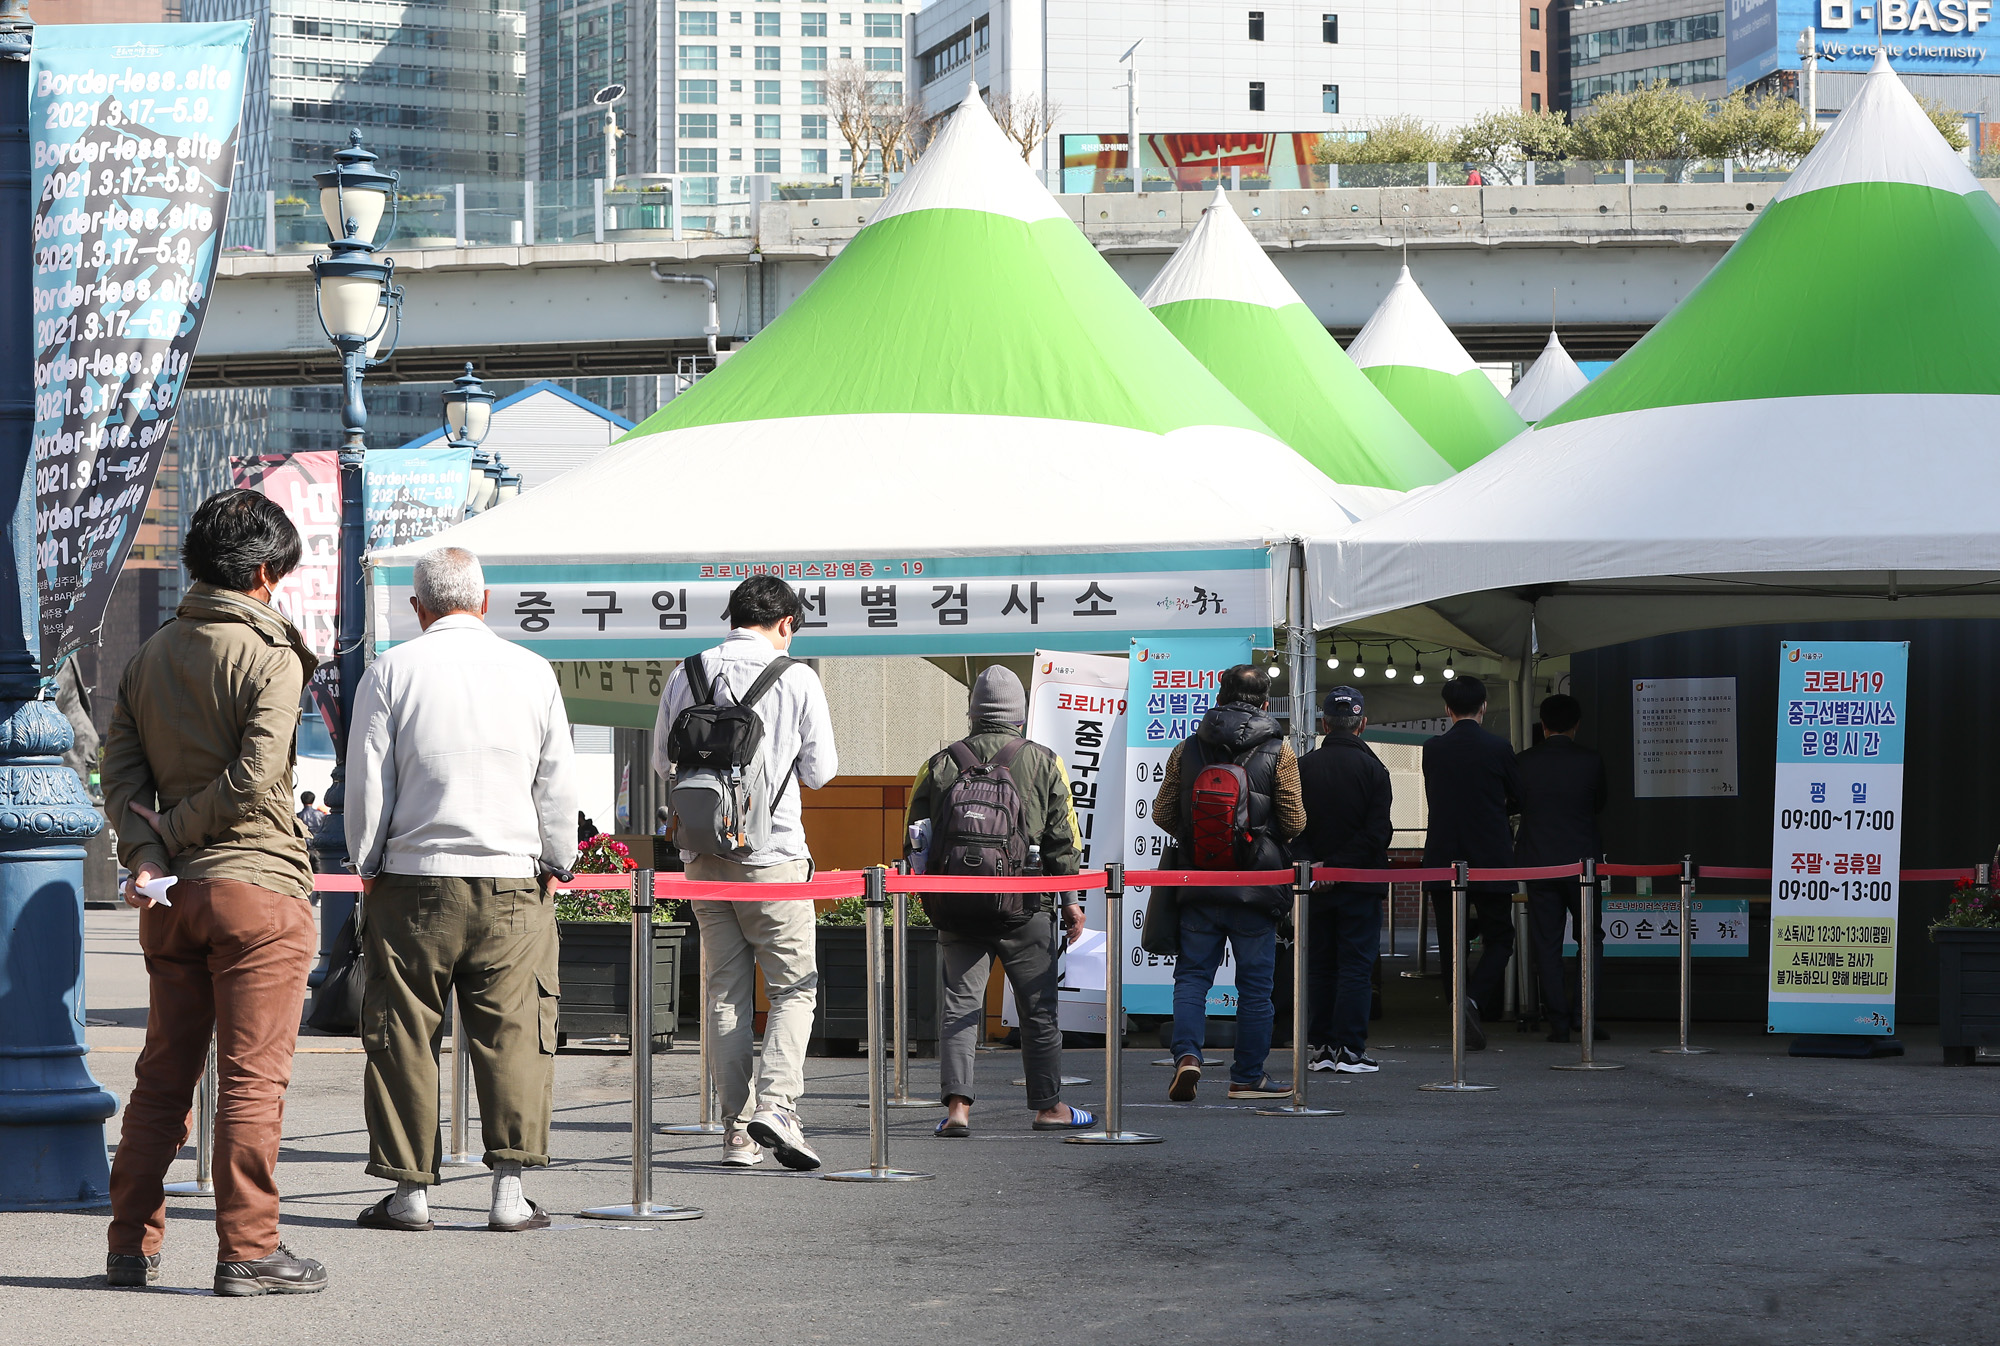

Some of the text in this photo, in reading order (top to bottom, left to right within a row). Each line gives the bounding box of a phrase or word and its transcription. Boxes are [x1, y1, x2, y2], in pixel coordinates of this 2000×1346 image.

[1882, 0, 1992, 33] BASF
[1822, 41, 1847, 55] We
[1908, 43, 1988, 61] chemistry
[699, 562, 875, 579] 코로나바이러스감염증
[900, 562, 925, 576] 19
[514, 581, 1118, 633] 중구임선별검사소
[1192, 585, 1225, 616] 중구
[1803, 671, 1884, 693] 코로나19
[1057, 692, 1127, 716] 코로나19
[1147, 693, 1216, 715] 선별검
[1788, 701, 1897, 726] 중구선별검사소
[1802, 730, 1881, 756] 운영시간
[1781, 809, 1895, 831] 09:00~17:00
[1778, 879, 1892, 902] 09:00~13:00
[1692, 902, 1703, 910] 19
[1817, 925, 1891, 944] 12:30~13:30(평일)
[1792, 952, 1874, 968] 소독시간에는 검사가
[1777, 970, 1889, 987] 불가능하오니 양해 바랍니다
